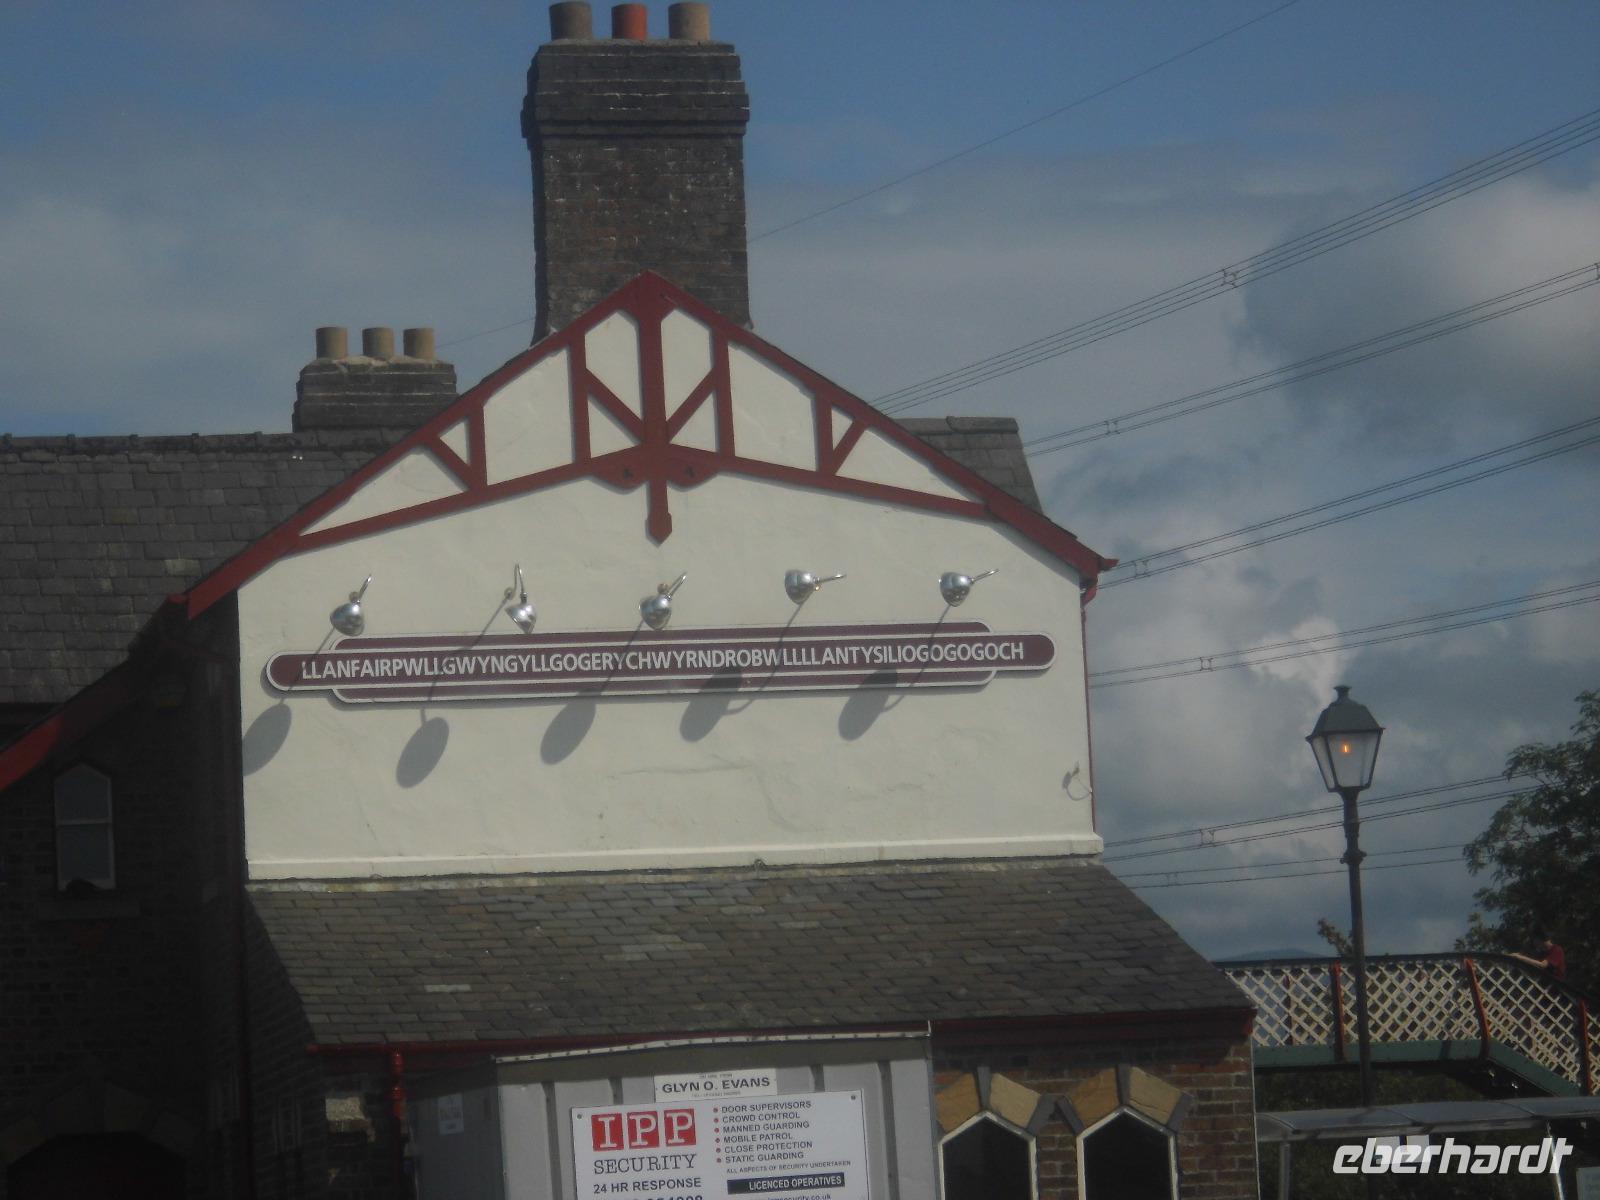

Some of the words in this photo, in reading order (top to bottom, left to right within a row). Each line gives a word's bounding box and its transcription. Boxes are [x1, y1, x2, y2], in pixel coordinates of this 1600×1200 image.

[662, 1082, 700, 1094] GLYN
[703, 1080, 717, 1091] O.
[722, 1077, 770, 1090] EVANS
[721, 1105, 747, 1114] DOOR
[749, 1100, 812, 1112] SUPERVISORS
[722, 1114, 755, 1124] CROWD
[758, 1112, 800, 1121] CONTROL
[599, 1111, 694, 1149] IPP
[723, 1124, 761, 1133] MANNED
[763, 1121, 810, 1131] GUARDING
[723, 1134, 757, 1143] MOBILE
[759, 1132, 793, 1141] PATROL
[724, 1144, 754, 1154] CLOSE
[756, 1141, 813, 1152] PROTECTION
[593, 1153, 697, 1175] SECURITY
[725, 1154, 755, 1164] STATIC
[757, 1151, 804, 1162] GUARDING
[810, 1160, 851, 1169] UNDERTAKEN
[593, 1183, 607, 1194] 24
[611, 1182, 628, 1192] HR
[632, 1177, 702, 1191] RESPONSE
[748, 1178, 789, 1191] LICENCED
[791, 1175, 842, 1188] OPERATIVES
